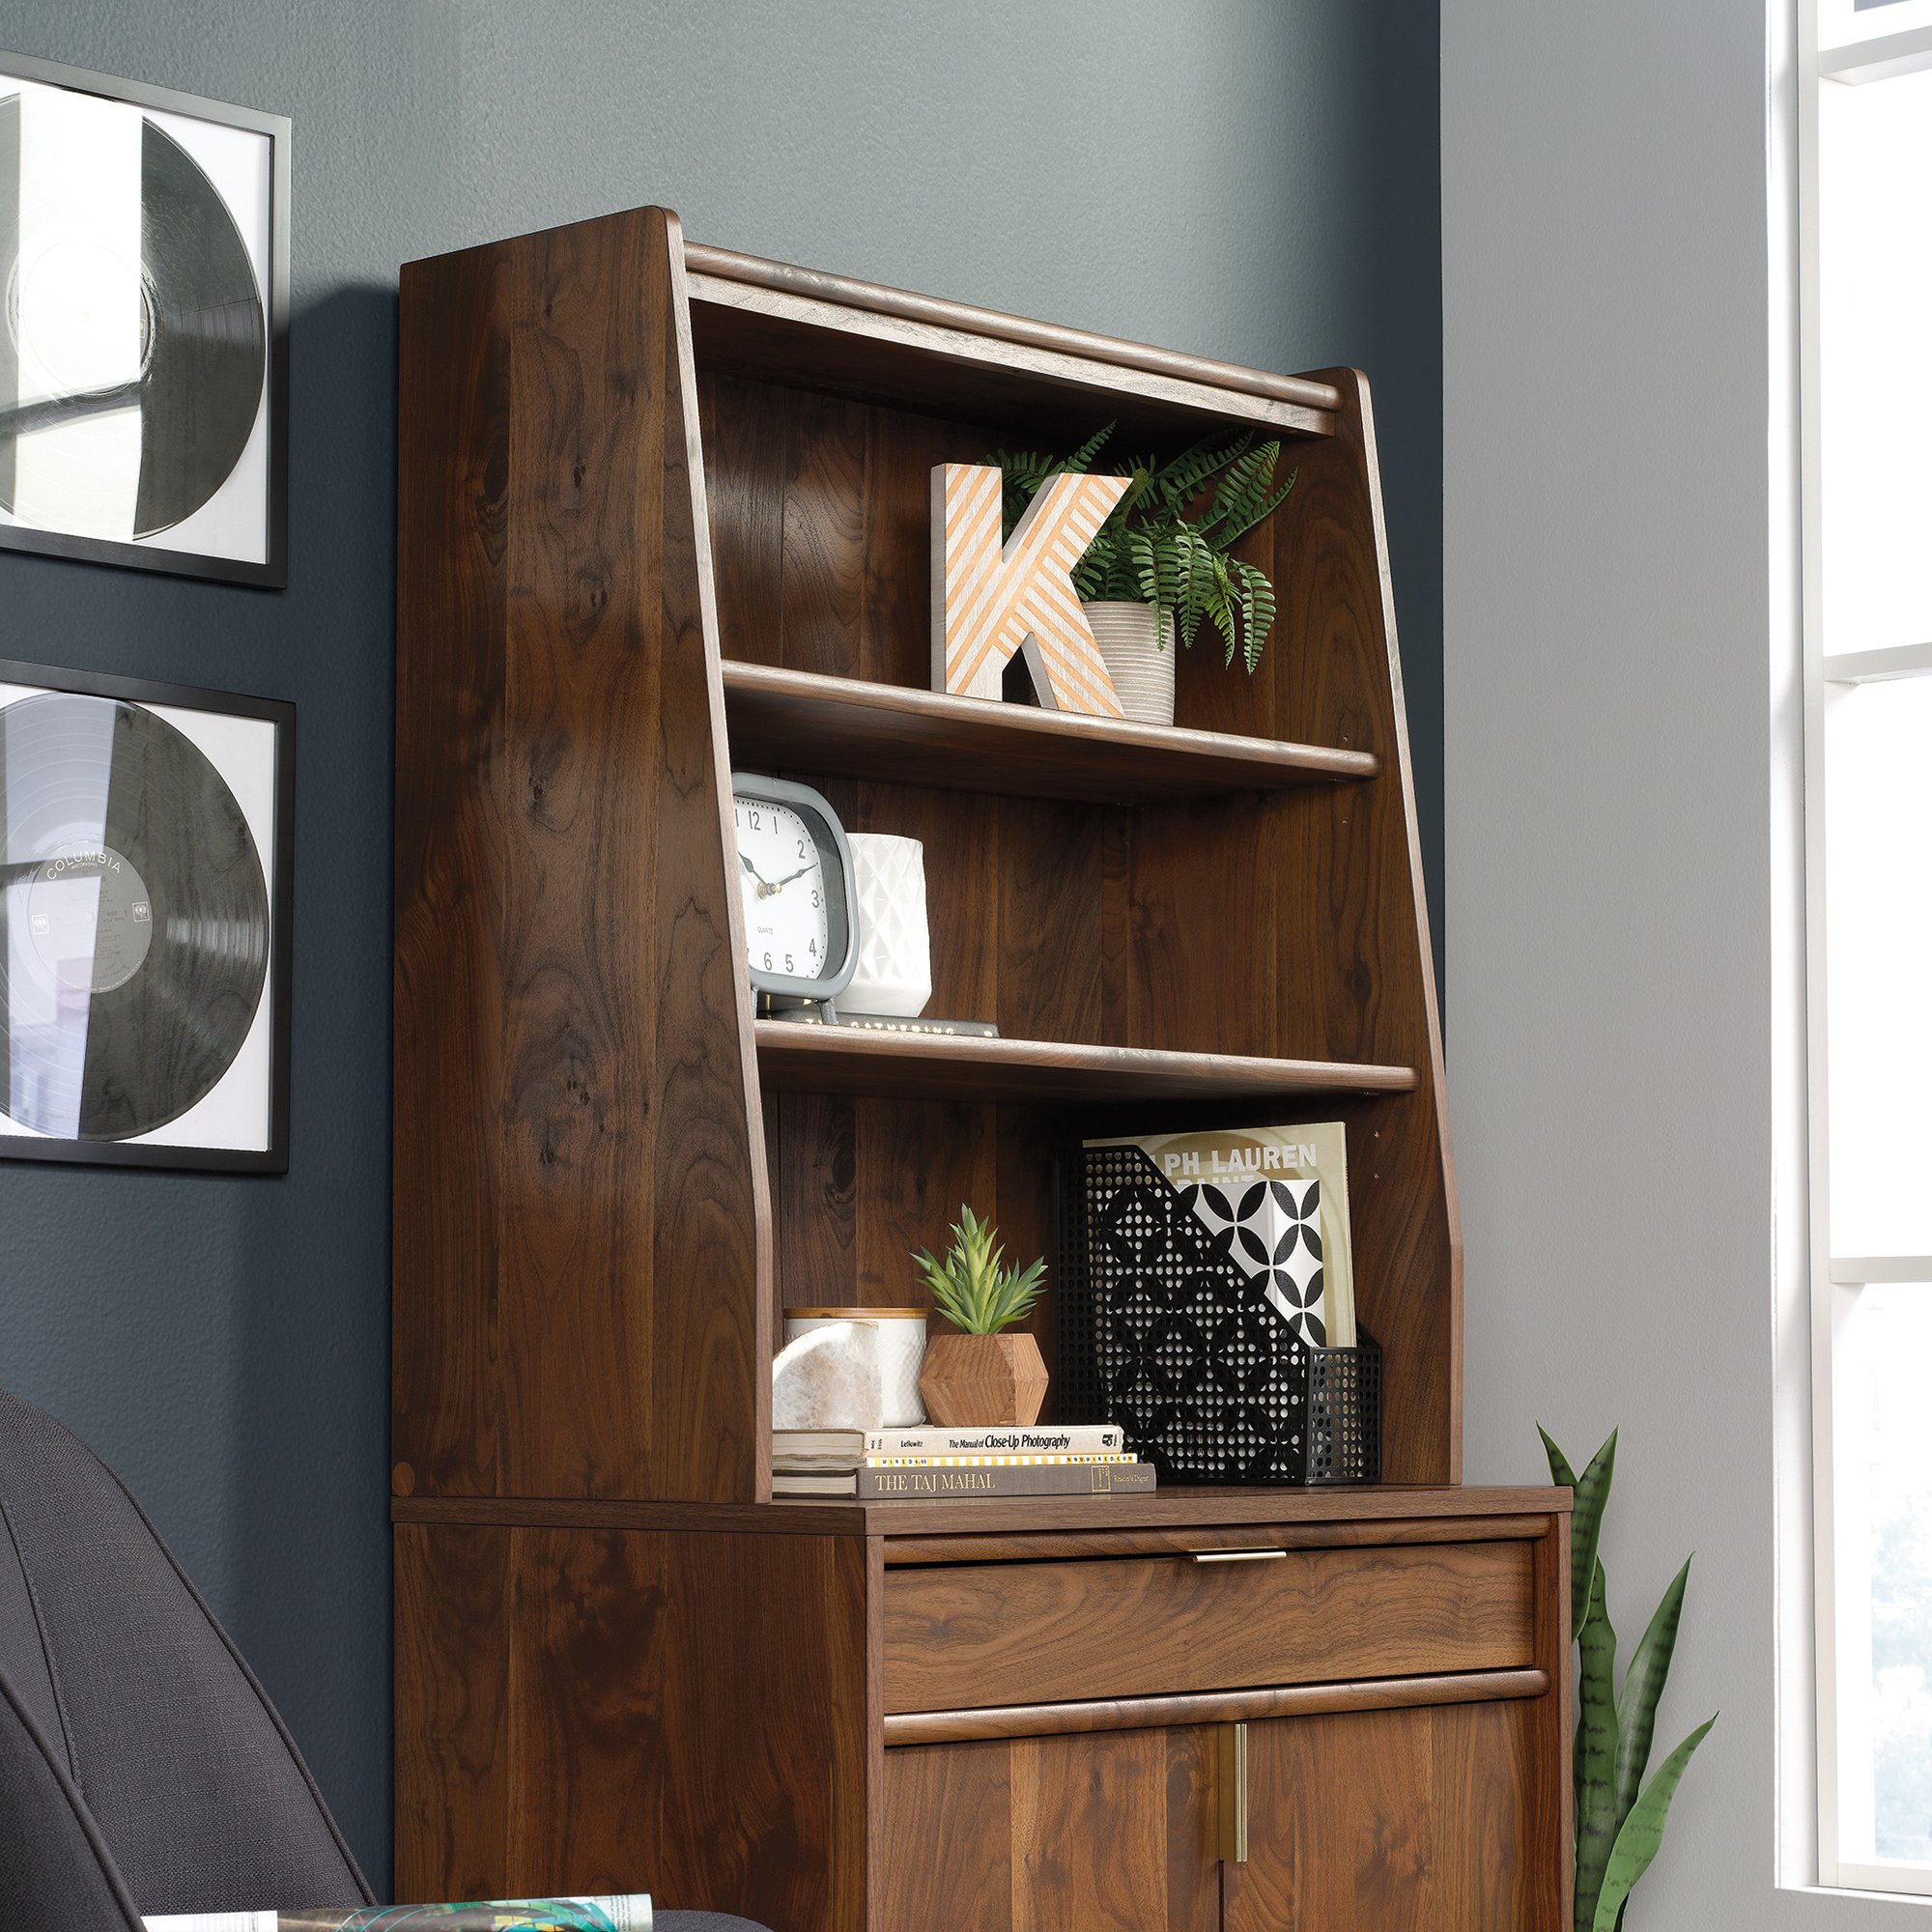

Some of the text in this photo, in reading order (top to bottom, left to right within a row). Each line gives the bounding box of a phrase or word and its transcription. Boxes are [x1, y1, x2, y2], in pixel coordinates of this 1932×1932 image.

[931, 463, 1134, 720] K
[734, 809, 779, 835] 1 12 1
[797, 838, 806, 860] 2
[46, 850, 121, 880] COLUMBIA
[810, 889, 820, 909] 3
[757, 926, 774, 935] QUARTZ
[809, 938, 817, 957] 4
[763, 952, 773, 972] 6
[784, 953, 794, 973] 5
[1211, 1143, 1317, 1174] LAUREN
[949, 1439, 959, 1448] The
[959, 1439, 978, 1449] Manual
[979, 1439, 984, 1448] of
[984, 1435, 1020, 1450] Close-Up
[1021, 1434, 1071, 1450] Photography
[874, 1472, 997, 1493] THE TAJ MAHAL
